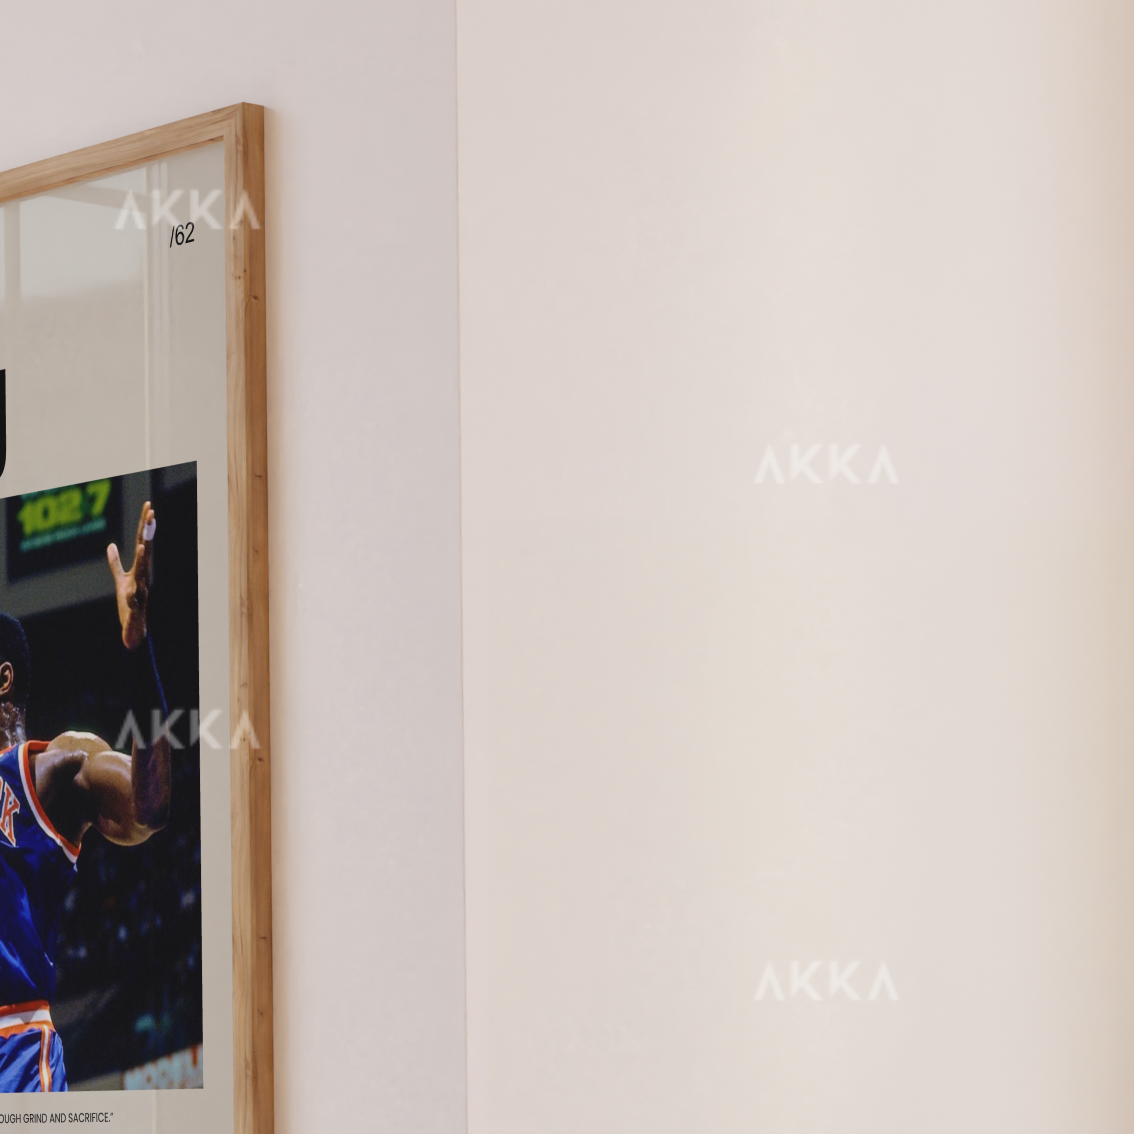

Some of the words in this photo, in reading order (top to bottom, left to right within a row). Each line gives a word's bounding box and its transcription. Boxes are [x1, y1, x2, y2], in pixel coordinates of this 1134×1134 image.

[169, 222, 195, 248] /62
[23, 1113, 48, 1124] GRIND
[50, 1113, 67, 1123] AND
